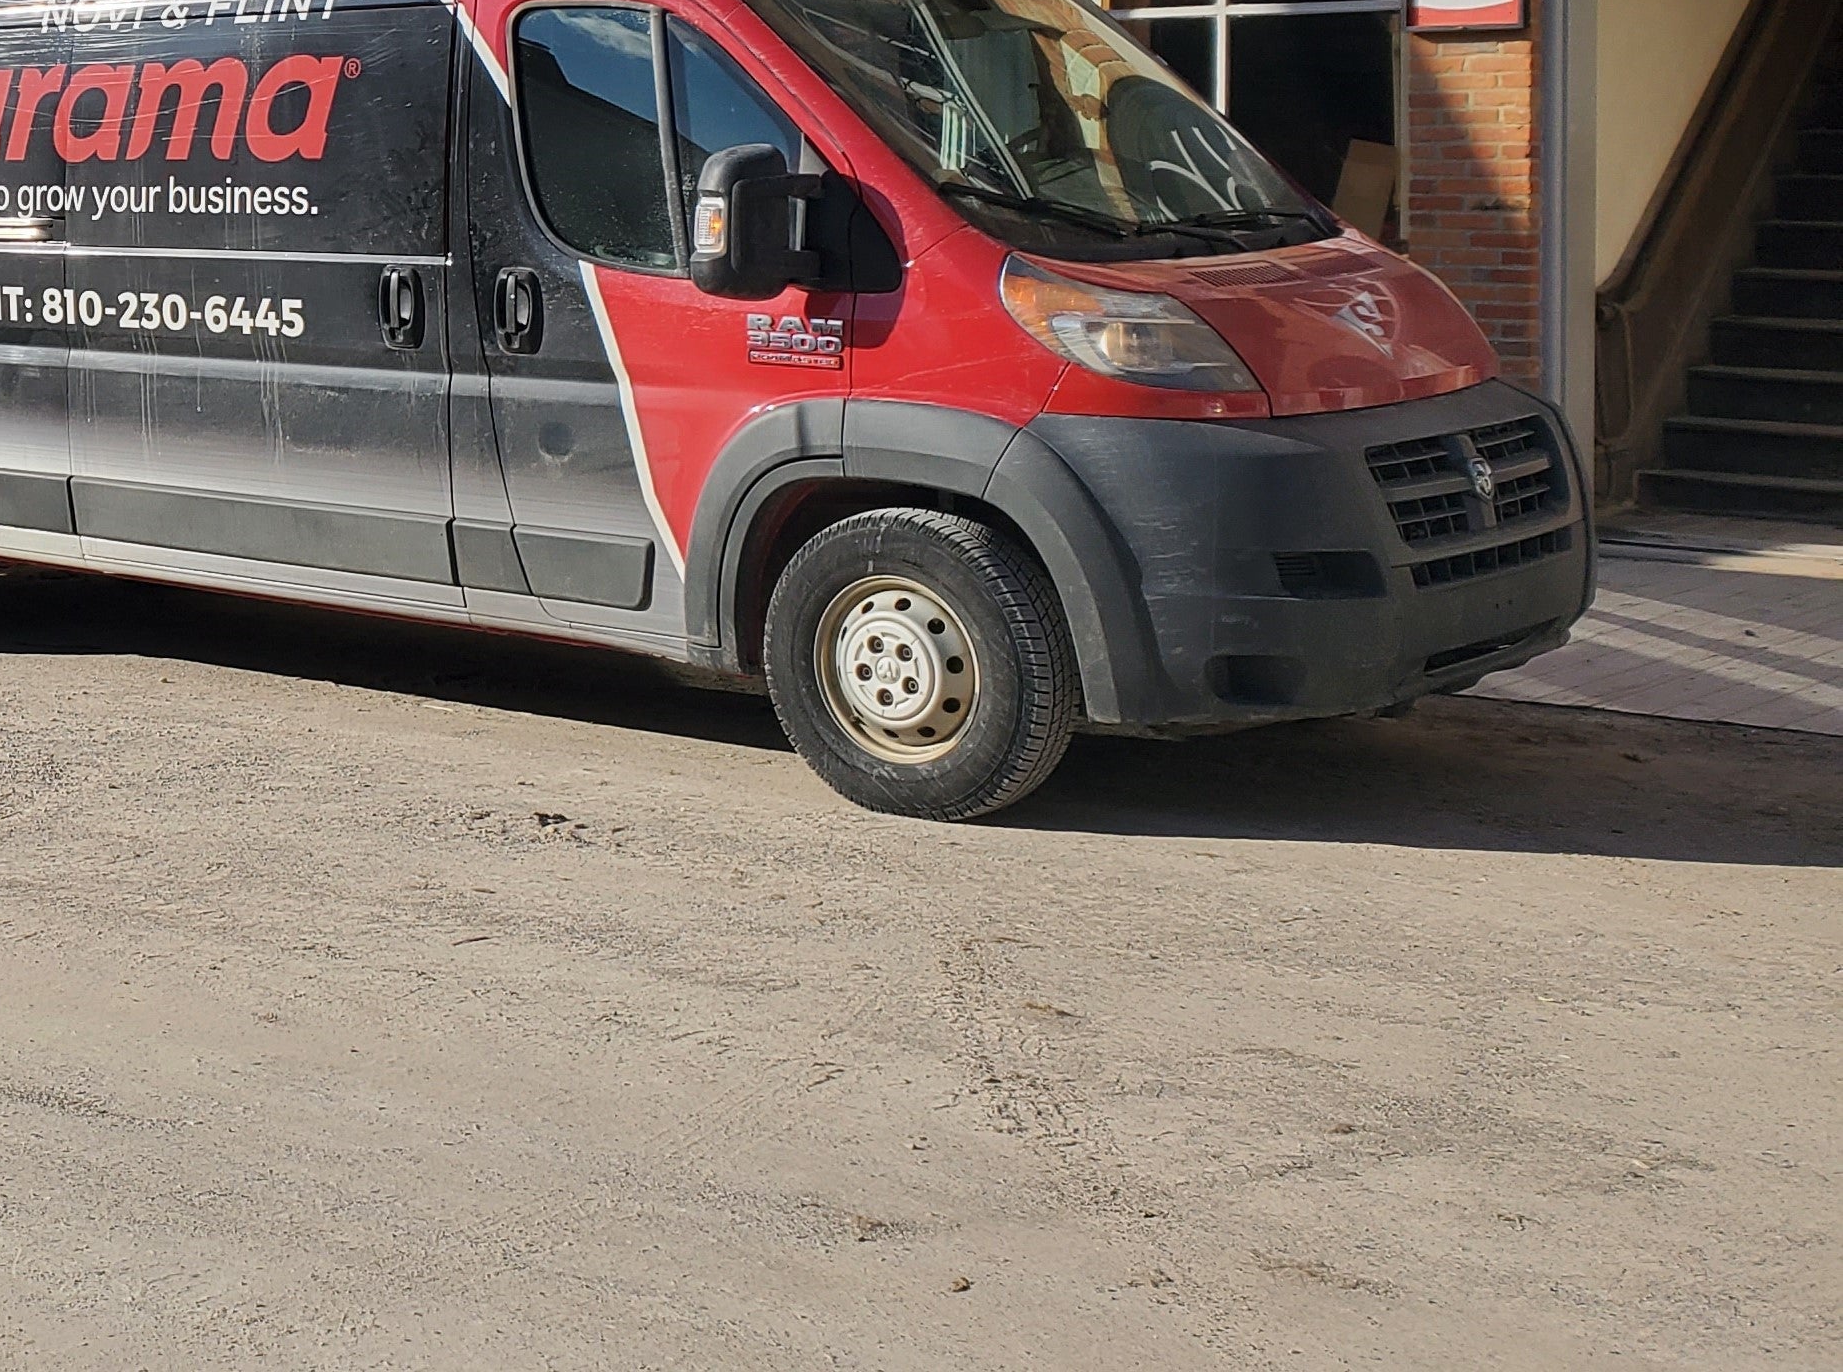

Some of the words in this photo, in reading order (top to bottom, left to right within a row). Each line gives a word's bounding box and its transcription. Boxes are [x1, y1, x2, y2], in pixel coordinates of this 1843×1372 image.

[17, 185, 84, 218] grow
[91, 185, 162, 220] your
[167, 175, 319, 215] business.
[42, 286, 305, 338] 810-230-6445
[747, 313, 844, 336] RAM
[747, 330, 842, 353] 3500
